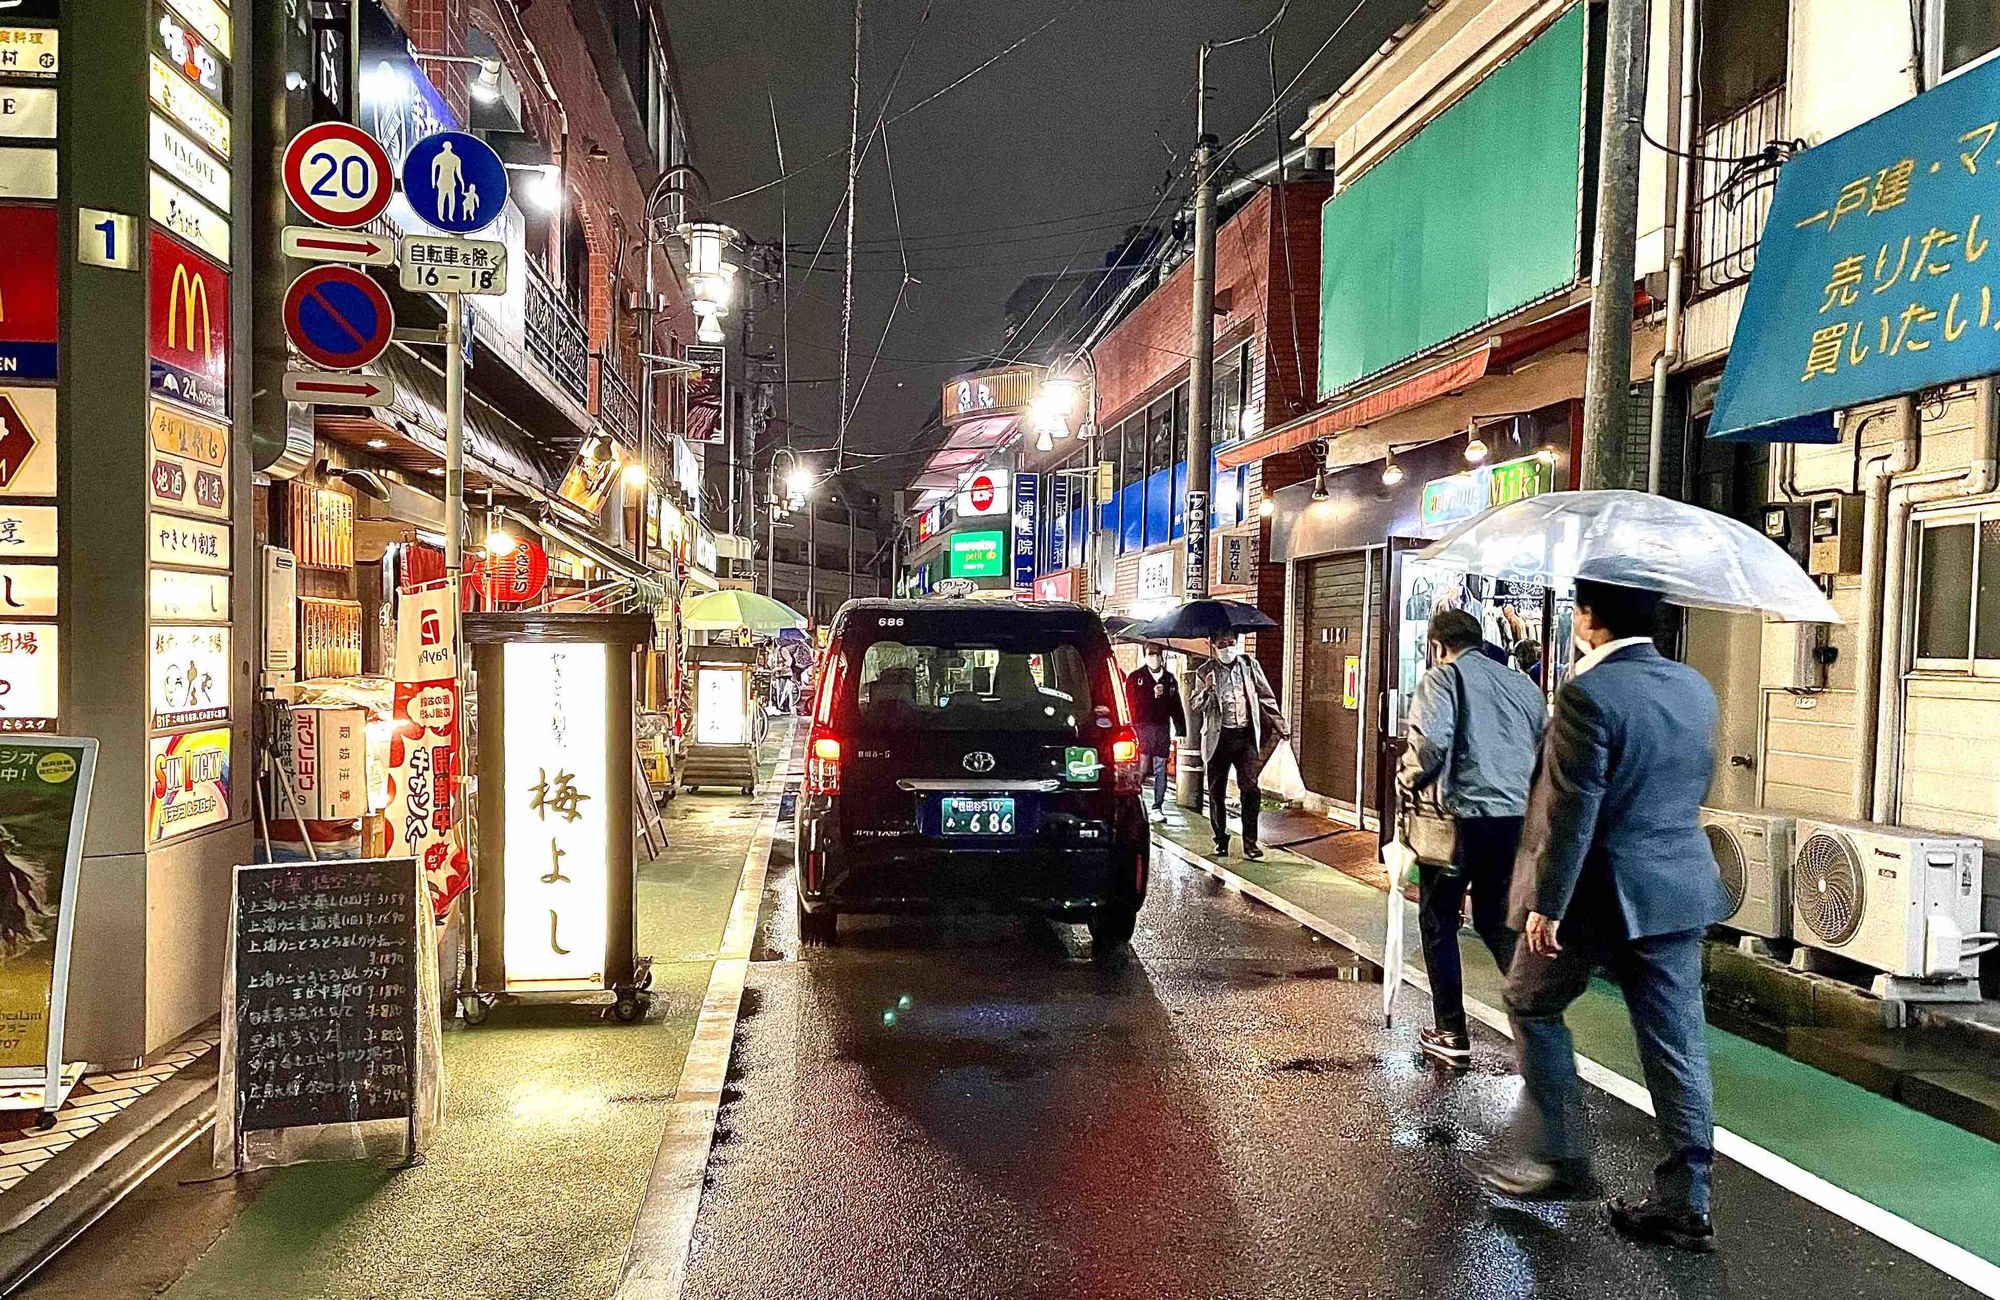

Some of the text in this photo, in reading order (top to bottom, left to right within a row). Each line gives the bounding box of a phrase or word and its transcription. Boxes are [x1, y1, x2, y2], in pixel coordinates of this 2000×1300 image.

[41, 56, 54, 68] 2F
[3, 98, 16, 115] E
[310, 152, 369, 199] 20
[1794, 121, 2000, 232] 一戸建・マ
[95, 219, 116, 259] 1
[410, 243, 499, 268] 自転車を除く
[1800, 285, 2000, 382] 買いたい
[156, 466, 184, 495] 地酒
[1488, 462, 1542, 508] Miki
[1017, 480, 1035, 556] 三浦医院
[159, 529, 219, 558] やきとり割烹
[1229, 539, 1241, 582] 処方せん
[878, 617, 905, 627] 686
[337, 726, 351, 801] 取扱注意
[526, 767, 592, 956] 梅よし
